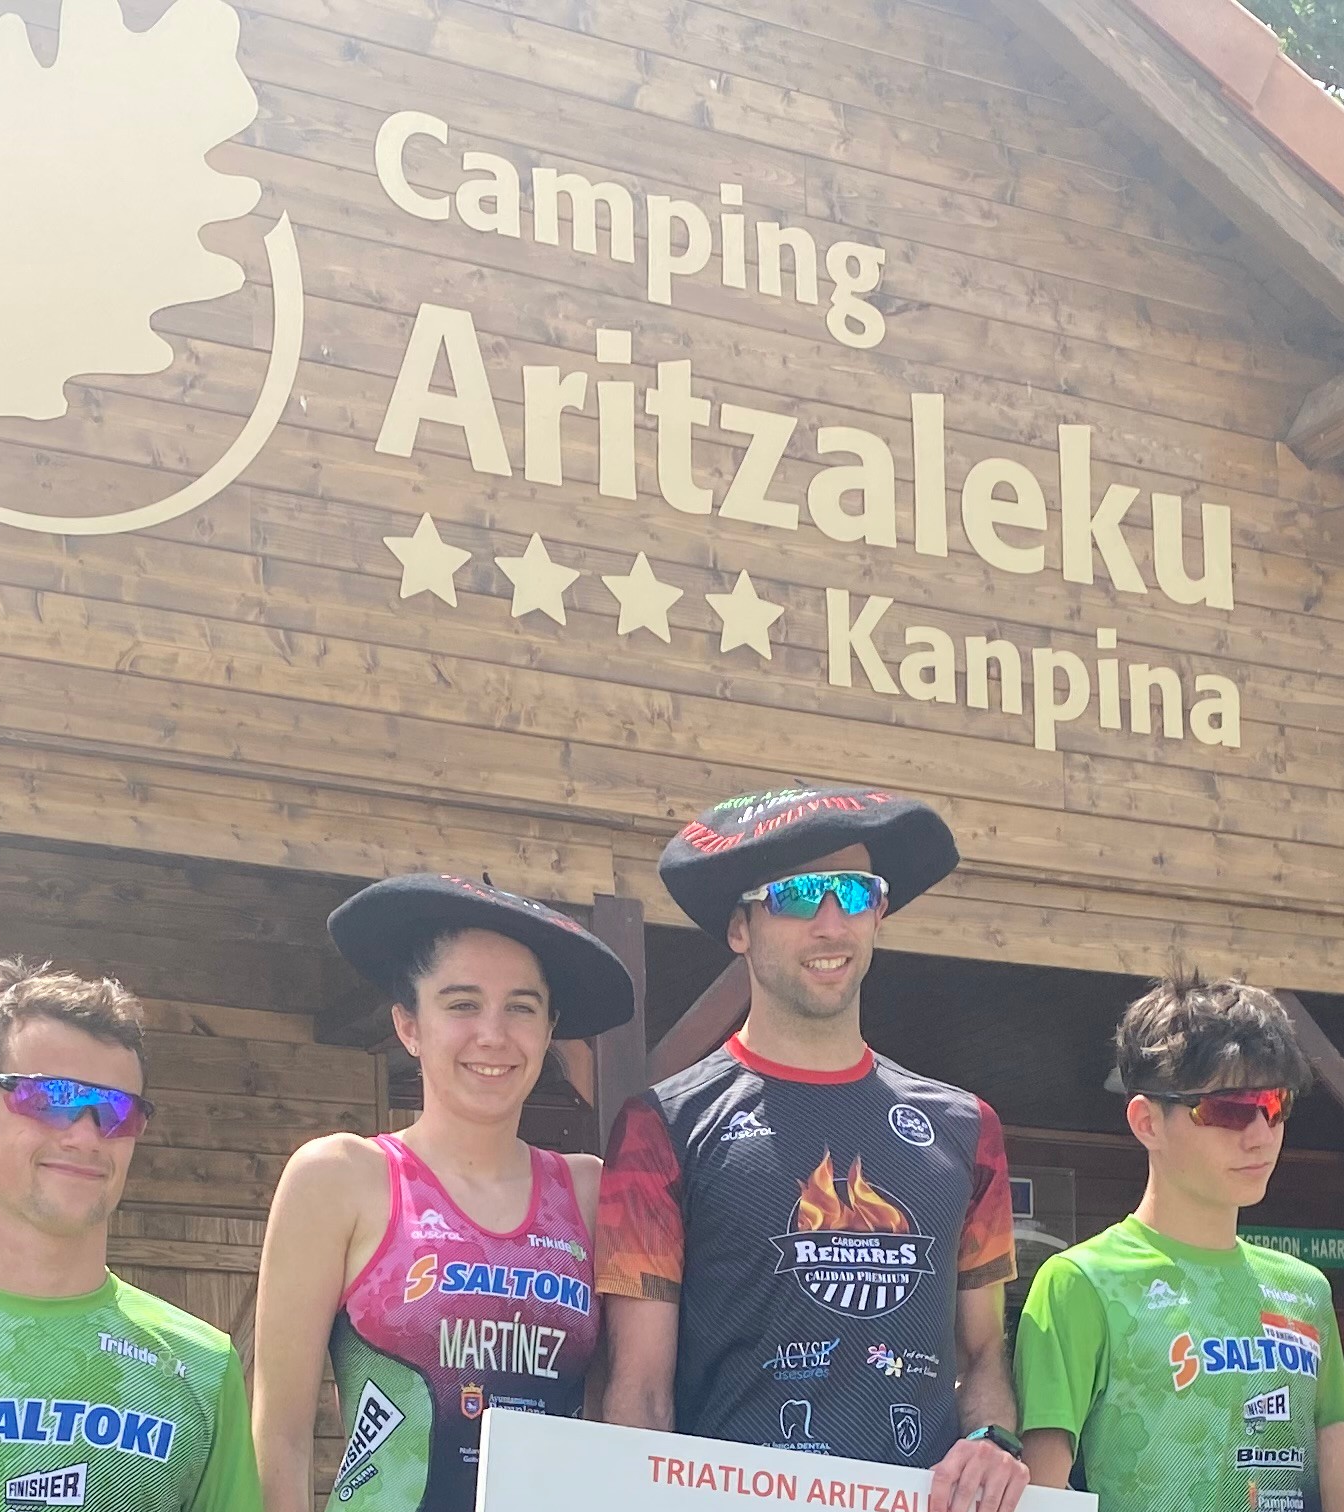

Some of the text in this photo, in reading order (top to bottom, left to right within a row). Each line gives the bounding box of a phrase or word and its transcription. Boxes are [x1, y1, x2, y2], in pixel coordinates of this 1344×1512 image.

[374, 111, 886, 349] Camping
[375, 302, 1233, 610] Aritzaleku
[827, 588, 1241, 752] Kanpina
[720, 1127, 776, 1142] austral
[411, 1230, 465, 1242] austral
[831, 1237, 880, 1247] CARBONES
[794, 1240, 917, 1265] REINARES
[439, 1261, 591, 1316] SALTOKI
[805, 1271, 909, 1283] CALIDAD PREMIUM
[439, 1311, 567, 1379] MARTÍNEZ
[774, 1341, 831, 1369] ACYSE
[1203, 1337, 1318, 1380] SALTOK
[773, 1368, 829, 1381] asesores
[797, 1442, 831, 1450] DENTAL
[8, 1472, 80, 1498] FINISHER
[648, 1455, 798, 1501] TRIATLON
